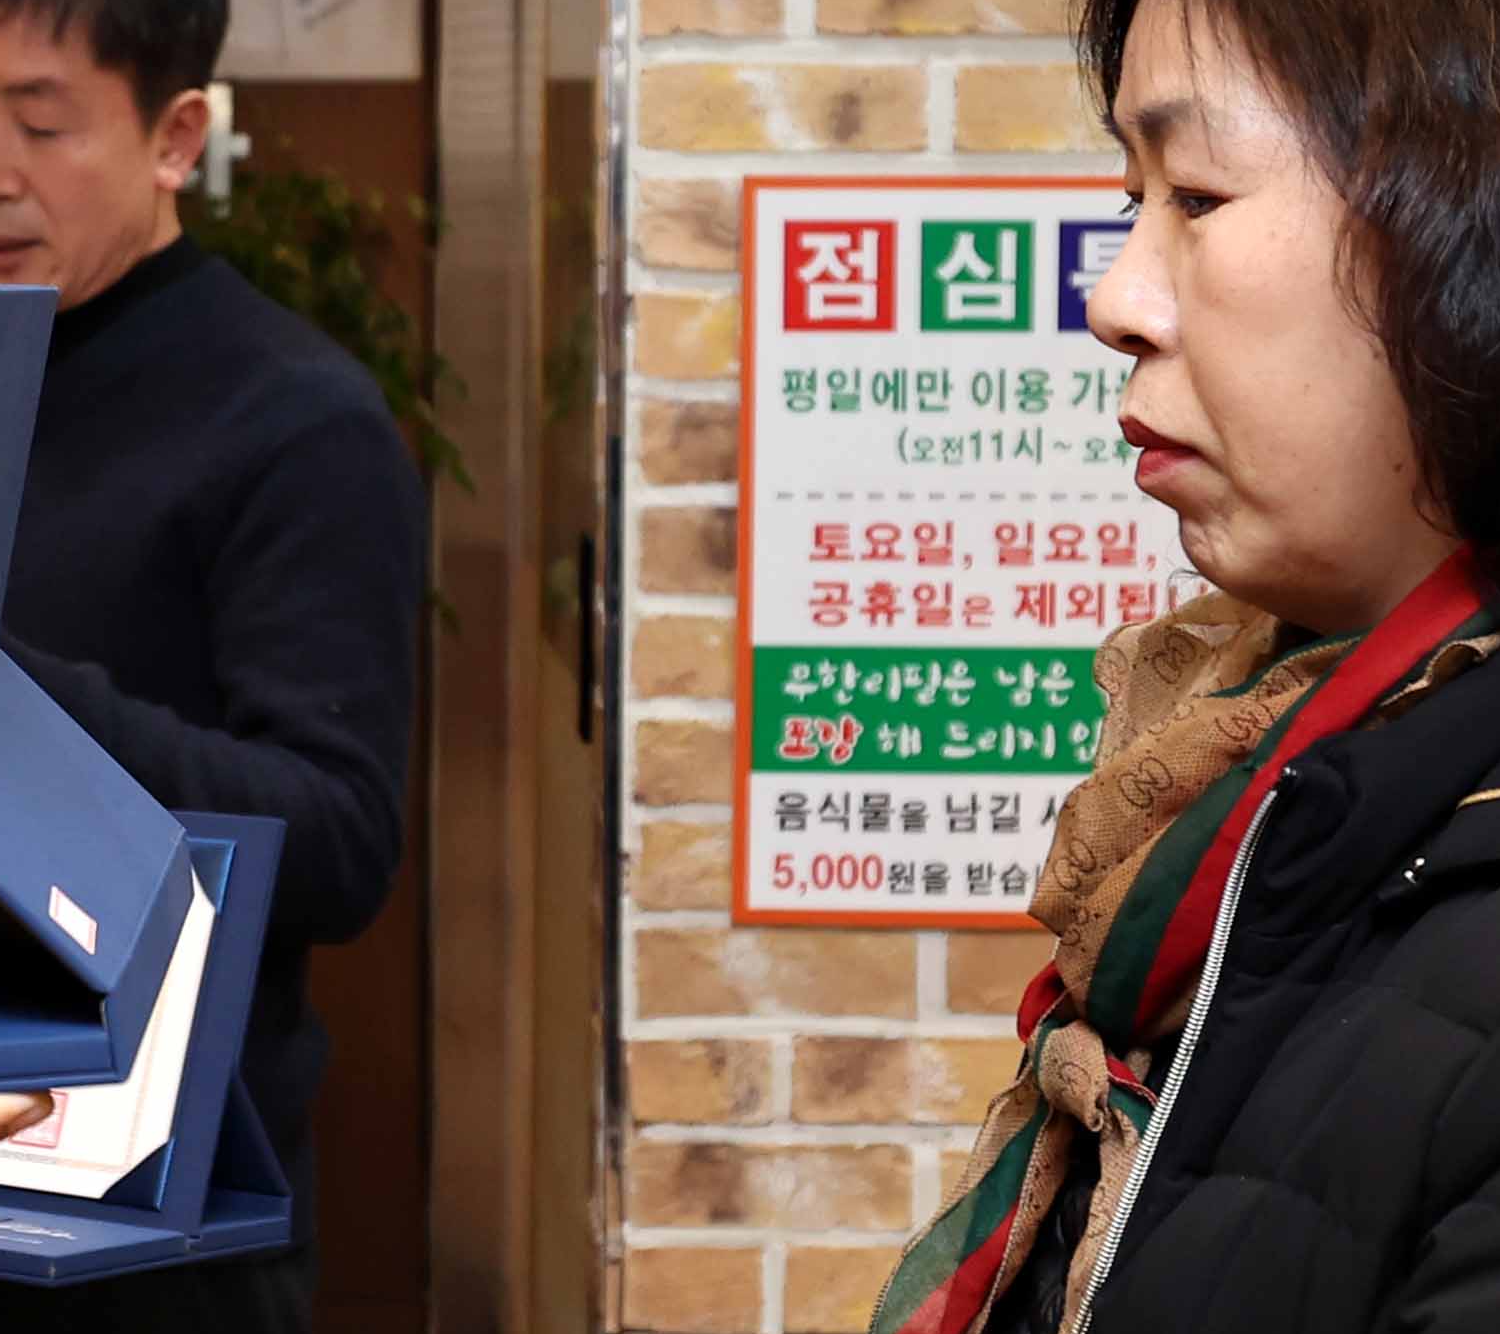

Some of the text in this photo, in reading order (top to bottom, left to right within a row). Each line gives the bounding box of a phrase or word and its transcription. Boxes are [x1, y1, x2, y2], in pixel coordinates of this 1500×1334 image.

[798, 229, 880, 322] 점
[935, 229, 1018, 322] 심
[782, 368, 1128, 414] 평일에만 이용 가
[897, 426, 1044, 465] (오전11시
[809, 521, 1158, 570] 토요일, 일요일,
[809, 581, 994, 628] 공휴일은
[783, 658, 1075, 707] 무한리필은 남은
[777, 714, 864, 764] 포장
[877, 721, 923, 759] 해
[941, 721, 1057, 760] 드리지
[775, 791, 929, 834] 음식물을
[945, 792, 1021, 834] 남길
[773, 853, 1041, 896] 5,000원을 받습
